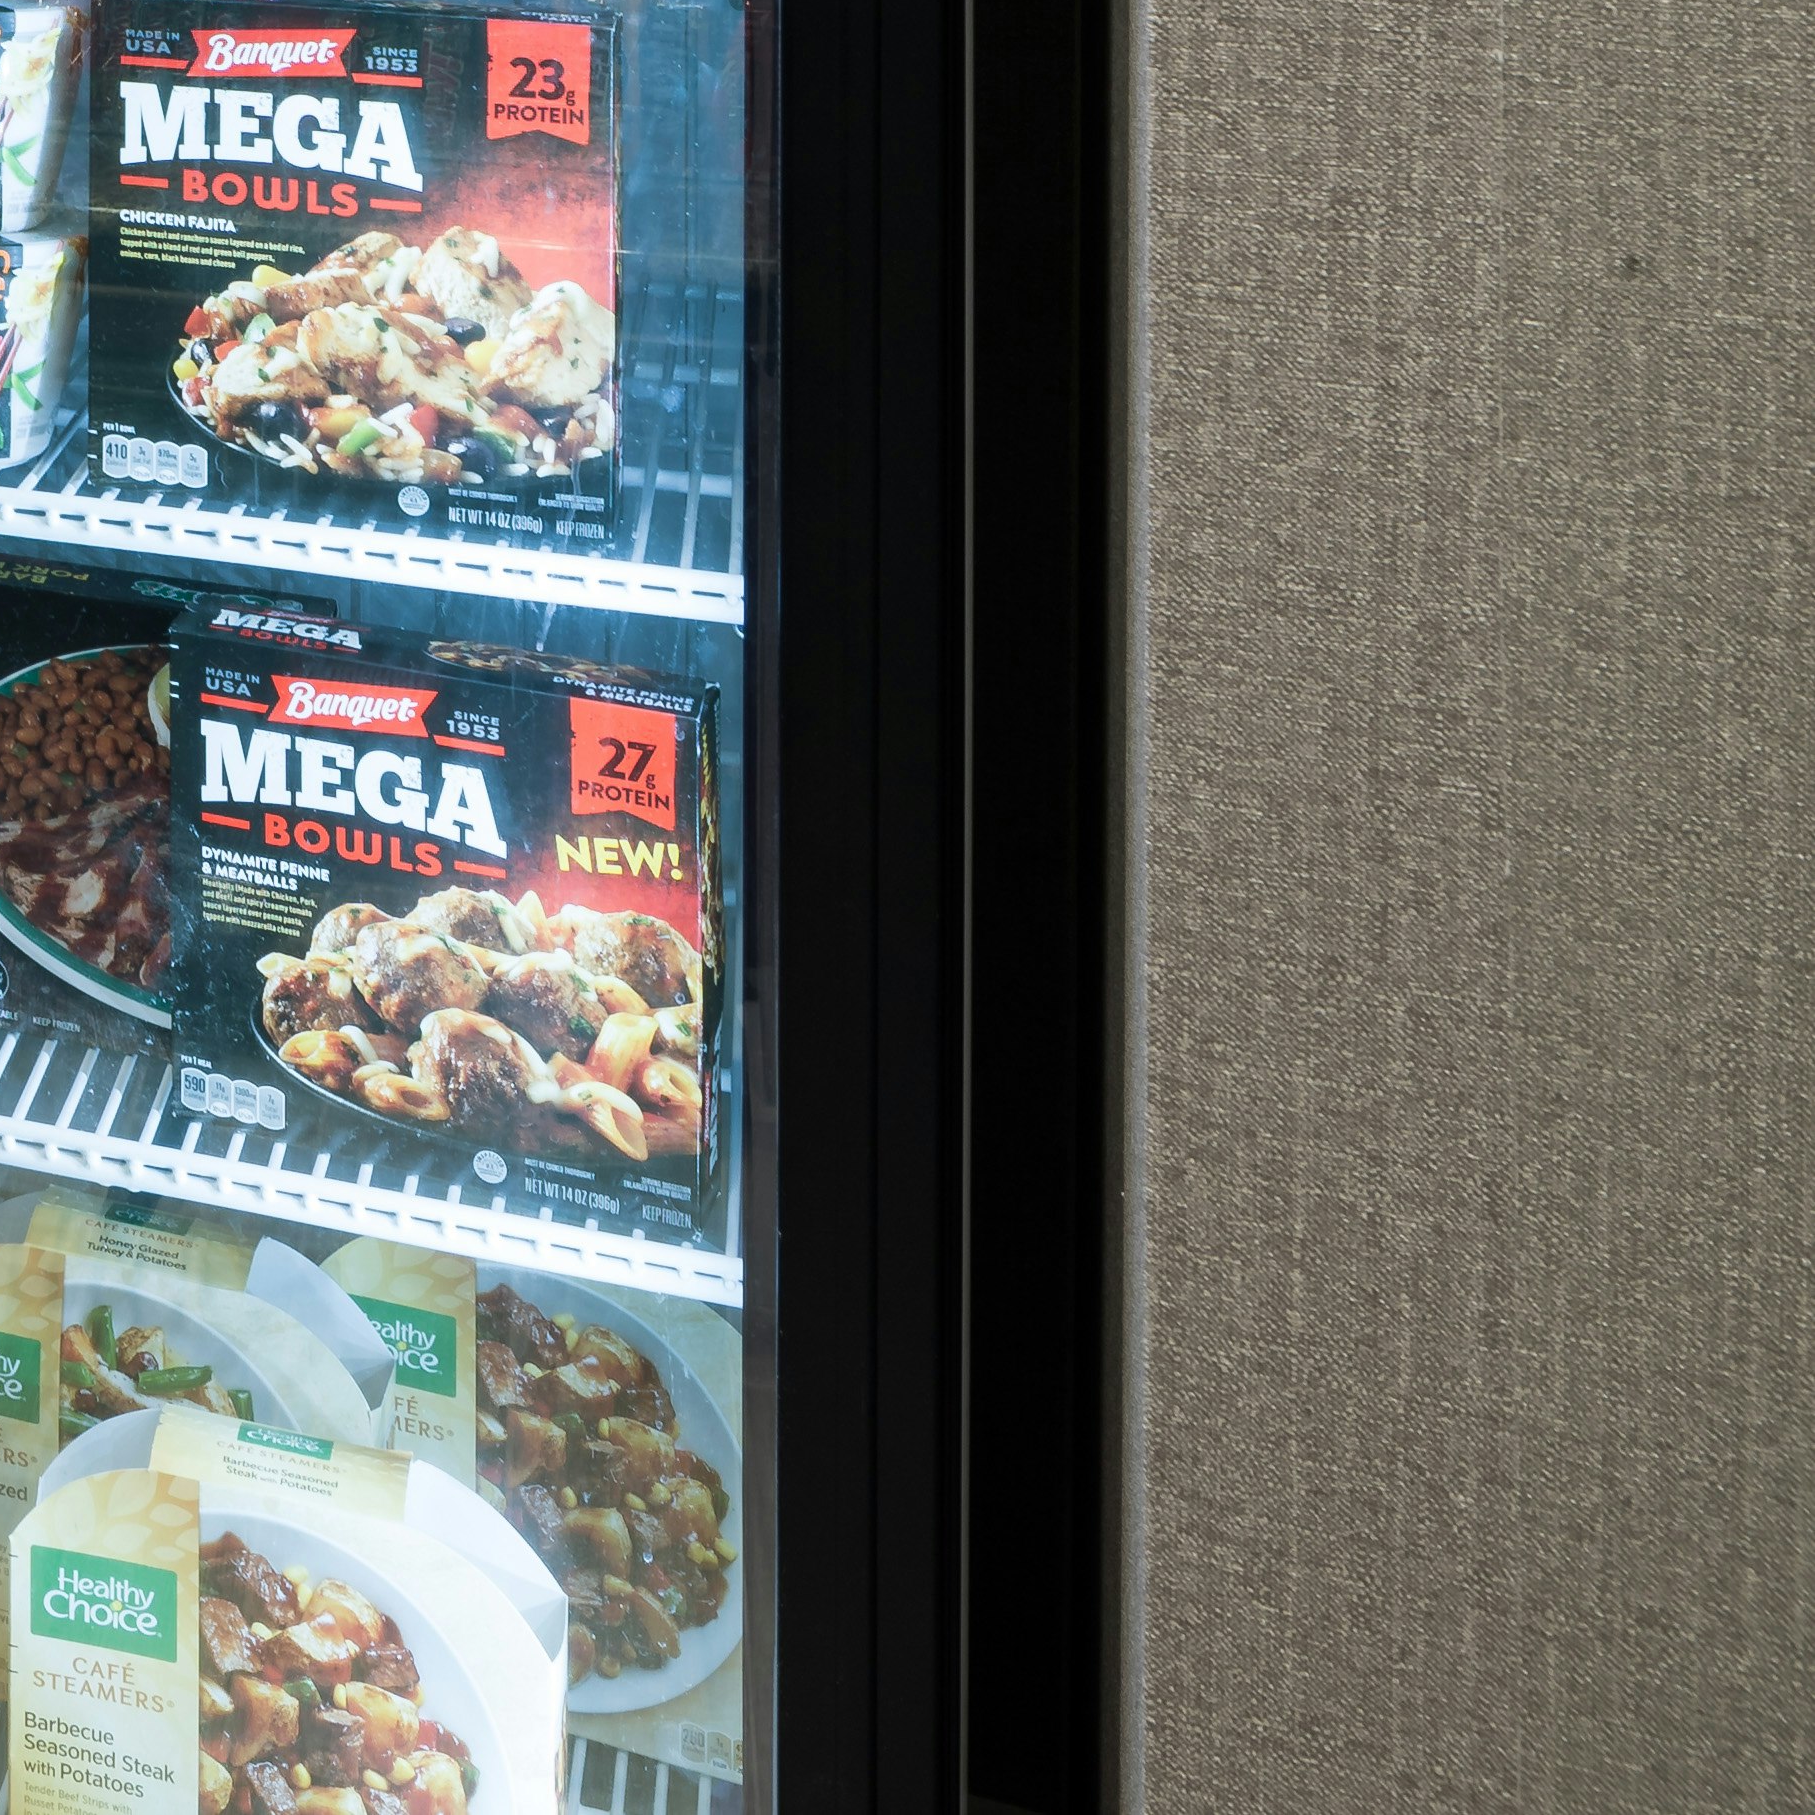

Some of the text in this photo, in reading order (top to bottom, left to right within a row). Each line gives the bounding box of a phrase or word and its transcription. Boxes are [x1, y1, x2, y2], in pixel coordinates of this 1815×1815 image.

[125, 29, 163, 41] MADE
[125, 39, 171, 55] USA
[372, 47, 418, 58] SINCE
[205, 34, 335, 74] Banquet
[365, 57, 418, 72] 1953
[494, 104, 584, 125] PROTEIN
[119, 82, 423, 193] MEGA
[182, 170, 359, 217] BOWLS
[119, 210, 235, 232] CHICKEN FAJITA
[106, 442, 128, 460] 410
[286, 681, 417, 725] Banquet
[201, 719, 507, 860] MEGA
[578, 781, 670, 810] PROTEIN
[265, 813, 442, 876] BOWLS
[555, 835, 682, 880] NEW!
[201, 847, 331, 882] DYNAMITE PENNE
[87, 1242, 124, 1257] Turkey
[136, 1252, 186, 1270] Potatoes
[99, 1235, 179, 1259] Honey Glazed
[57, 1566, 155, 1610] Healthy
[42, 1590, 162, 1637] Choice
[70, 1658, 136, 1685] CAFÉ
[32, 1669, 175, 1714] STEAMERS
[24, 1711, 115, 1745] Barbecue
[22, 1735, 175, 1783] Seasoned Steak
[22, 1759, 144, 1799] with Potatoes
